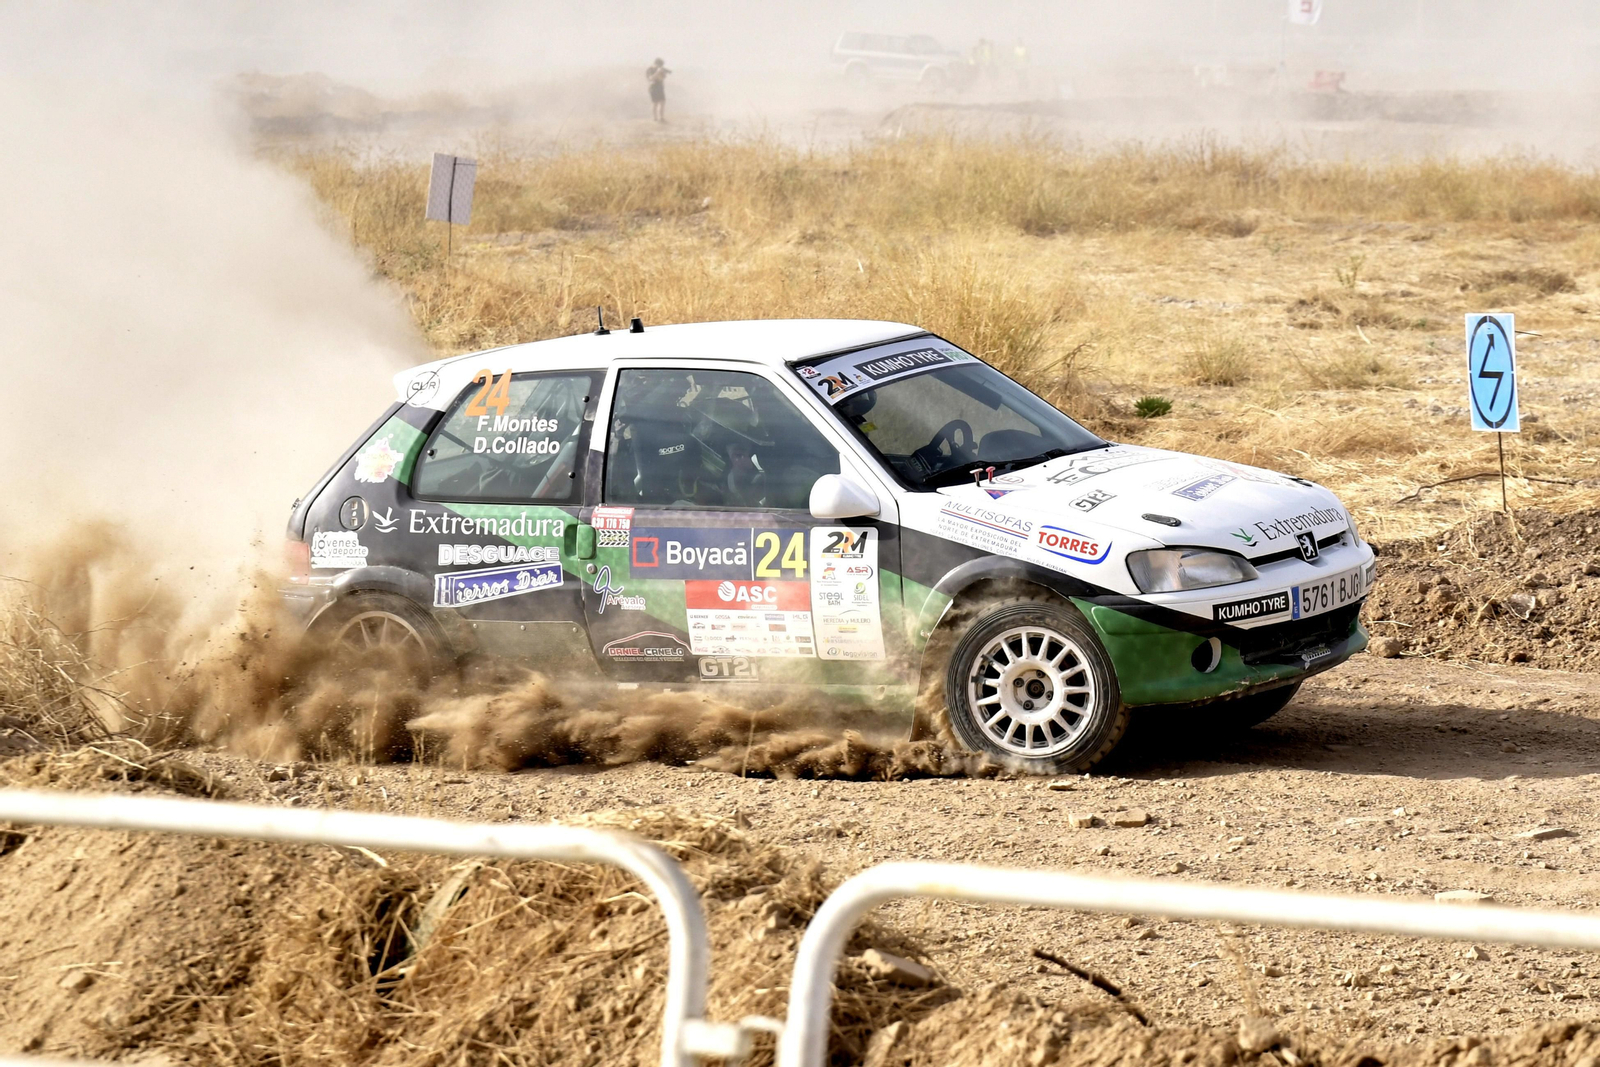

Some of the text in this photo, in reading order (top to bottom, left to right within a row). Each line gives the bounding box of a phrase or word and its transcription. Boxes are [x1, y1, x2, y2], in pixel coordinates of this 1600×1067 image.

[862, 355, 914, 376] KUMHO
[908, 350, 945, 364] TYRE
[464, 368, 512, 417] 24
[476, 415, 558, 433] F.Montes
[473, 436, 560, 454] D.Collado
[409, 509, 564, 537] Extremadura
[944, 500, 1033, 532] MULTISOFAS
[1253, 506, 1343, 541] Extremadura
[938, 524, 958, 534] NORTE
[970, 534, 1018, 553] EXTREMADURA
[947, 519, 969, 531] MAYOR
[1010, 538, 1022, 548] DEL
[1038, 531, 1099, 556] TORRES
[438, 544, 560, 566] DESGUACE
[666, 531, 807, 578] Boyacá 24
[736, 586, 777, 602] ASC
[1302, 581, 1335, 613] 5761
[1339, 572, 1359, 599] BJG
[1218, 596, 1286, 620] KUMHO TYRE
[608, 647, 644, 656] DANIEL
[644, 647, 684, 656] CANELO
